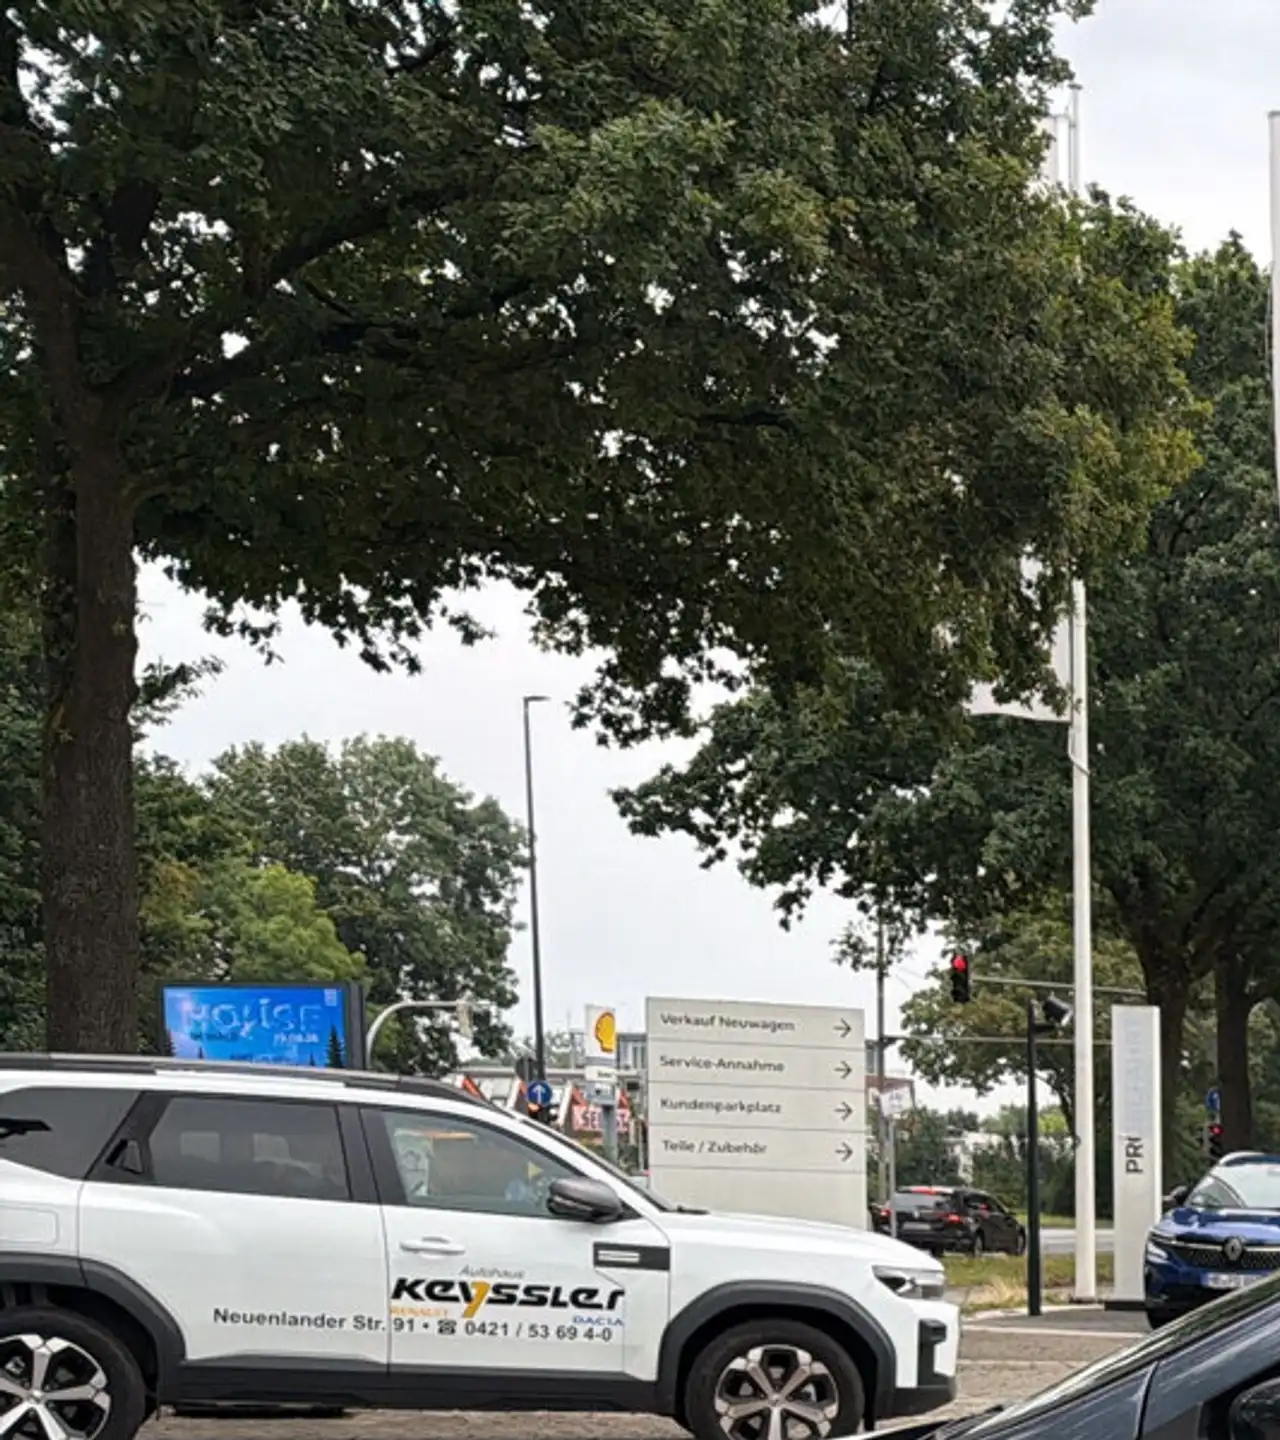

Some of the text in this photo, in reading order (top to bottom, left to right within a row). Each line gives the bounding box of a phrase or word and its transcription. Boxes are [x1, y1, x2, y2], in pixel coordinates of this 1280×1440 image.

[660, 1012, 795, 1033] Verkauf Neuwagen
[659, 1055, 786, 1073] Service-Annahme
[660, 1098, 782, 1115] Kundenparkplatz
[663, 1140, 694, 1153] Teile
[708, 1140, 768, 1154] Zubehör
[213, 1308, 347, 1329] Neuenlander
[353, 1315, 386, 1331] Str.
[393, 1318, 414, 1332] 91
[465, 1321, 509, 1336] 0421
[527, 1324, 550, 1338] 53
[556, 1325, 578, 1340] 69
[583, 1326, 613, 1341] 4-0
[572, 1315, 625, 1326] DACIA
